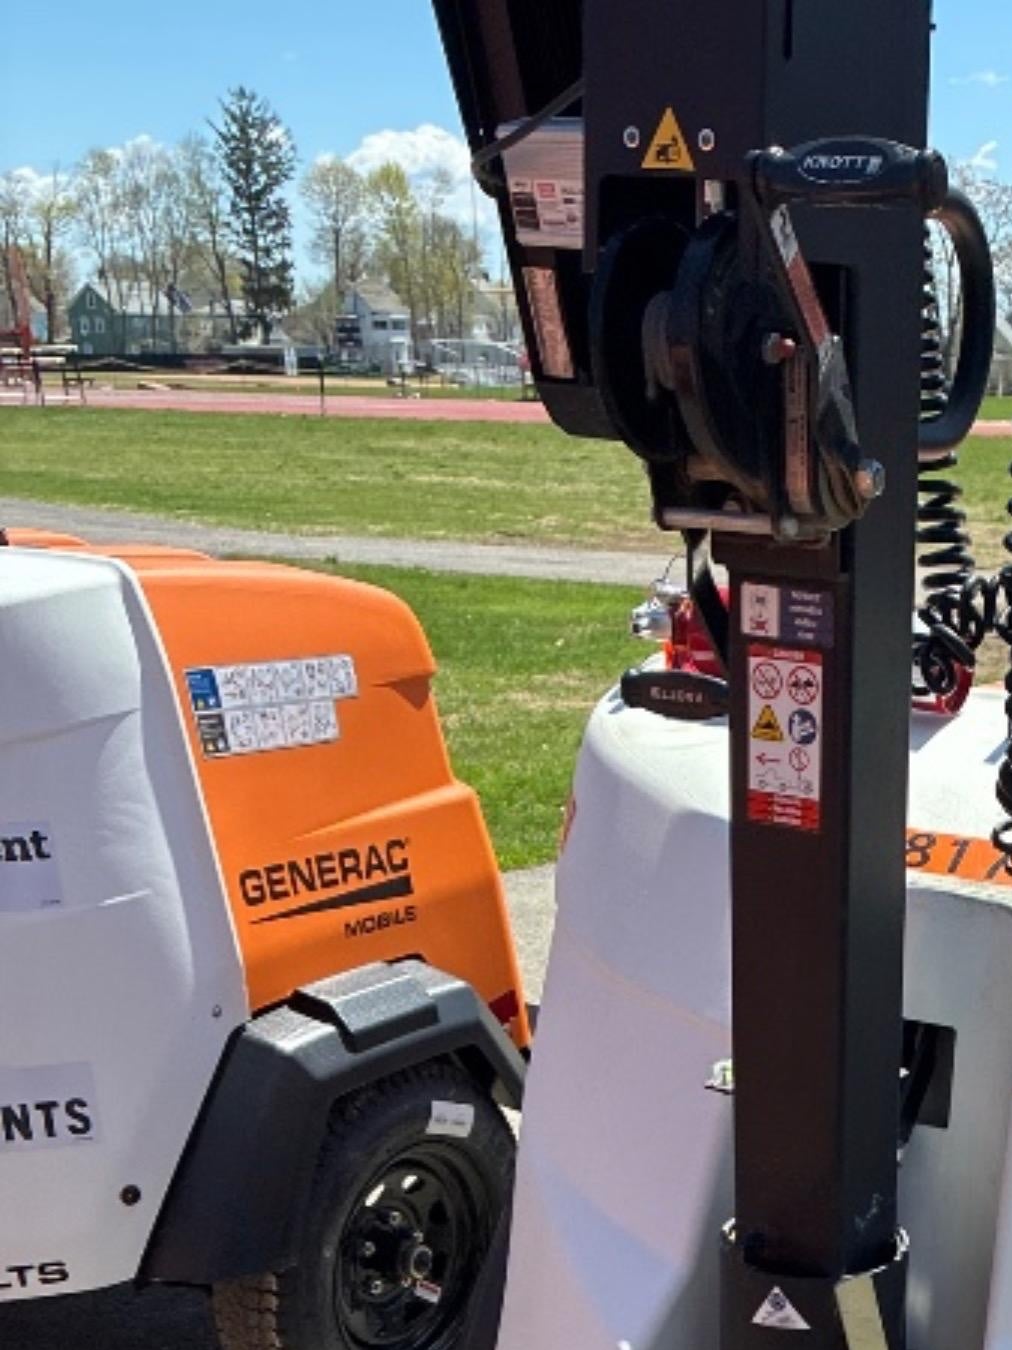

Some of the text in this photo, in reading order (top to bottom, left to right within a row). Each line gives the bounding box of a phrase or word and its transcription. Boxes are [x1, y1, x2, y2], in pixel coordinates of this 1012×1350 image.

[803, 155, 869, 170] KNOTT
[239, 839, 410, 906] GENERAC
[344, 906, 417, 938] MOBILE
